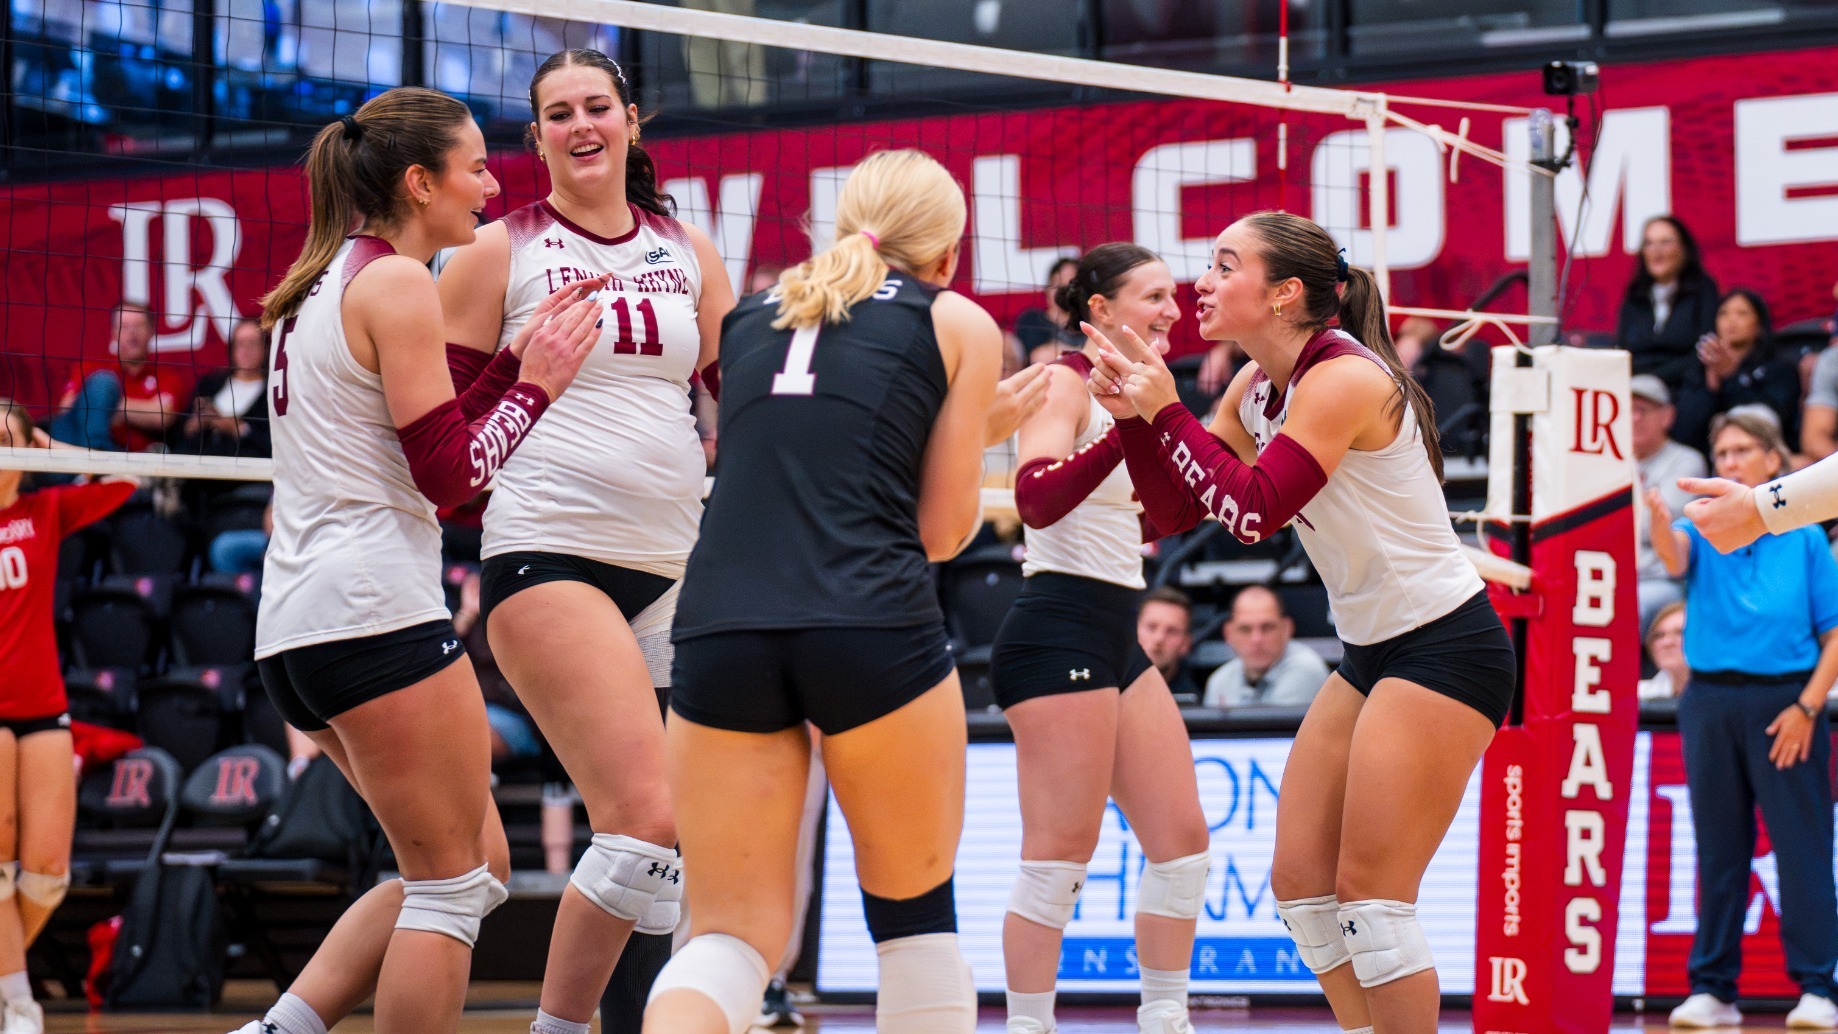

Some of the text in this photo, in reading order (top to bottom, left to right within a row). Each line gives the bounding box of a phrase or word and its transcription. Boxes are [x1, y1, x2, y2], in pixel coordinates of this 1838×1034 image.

[107, 197, 244, 355] LR
[273, 315, 299, 417] 5
[611, 297, 663, 356] 11
[770, 322, 823, 396] 1
[1568, 387, 1624, 461] LR
[1561, 550, 1617, 974] BEARS
[1501, 764, 1524, 937] sports imports
[1487, 956, 1530, 1006] LR
